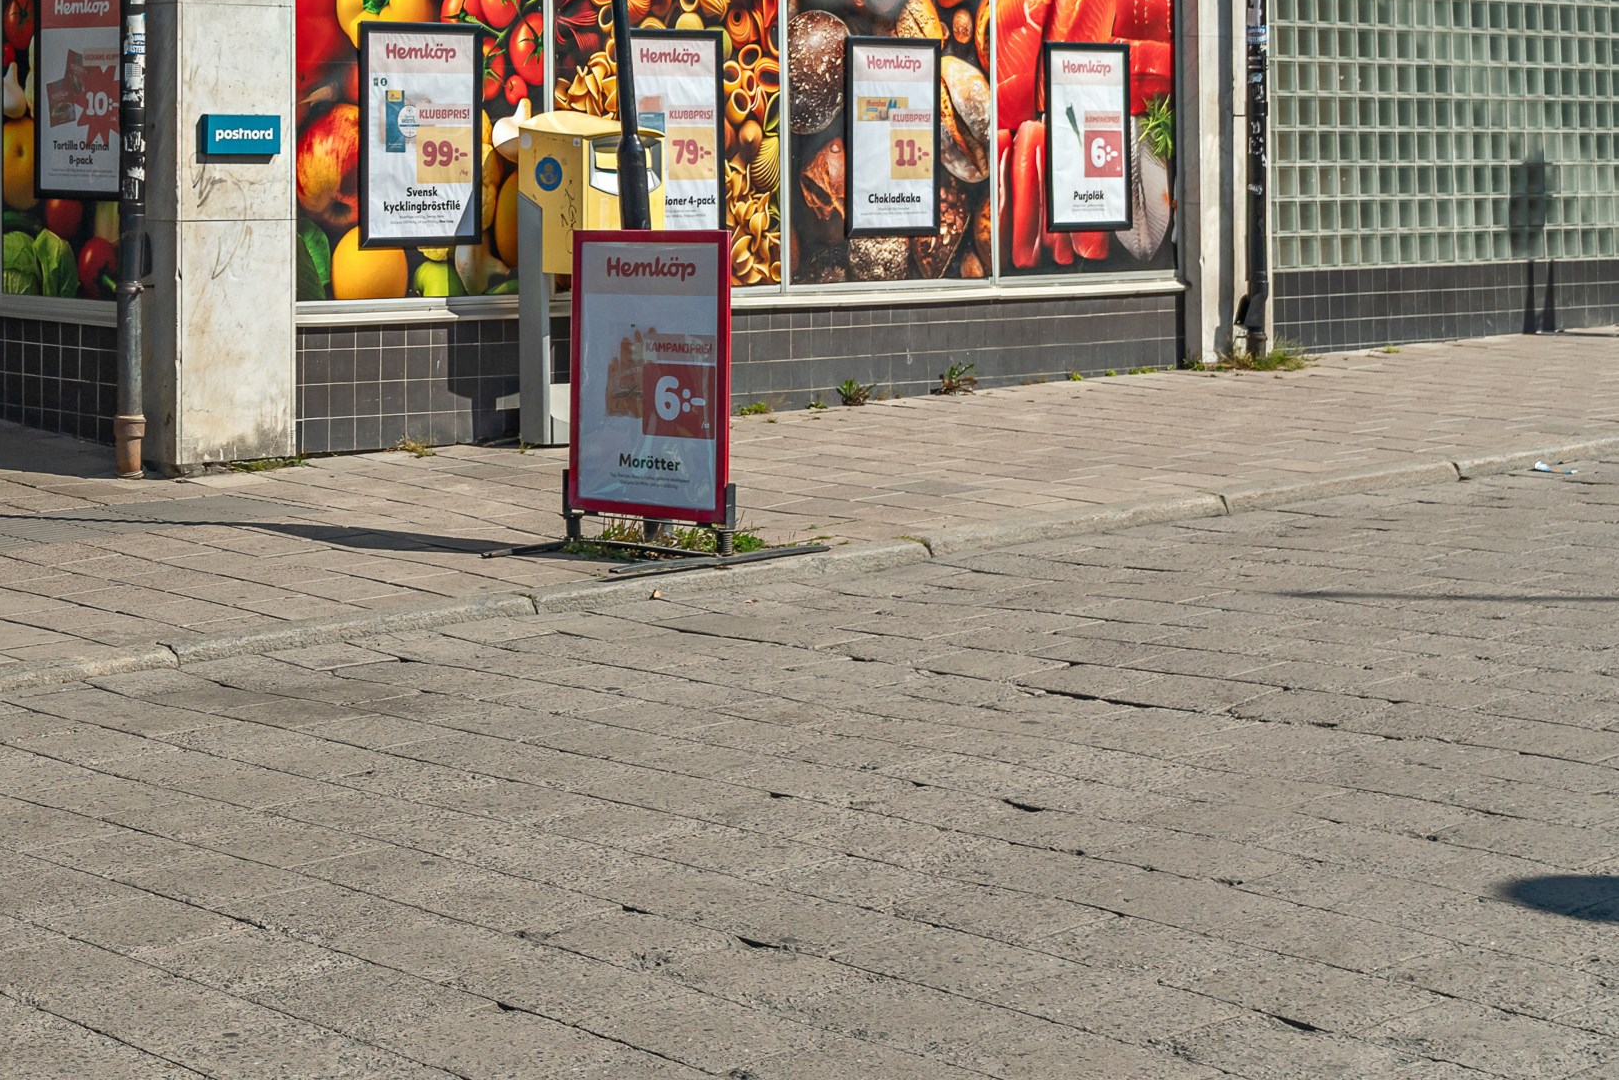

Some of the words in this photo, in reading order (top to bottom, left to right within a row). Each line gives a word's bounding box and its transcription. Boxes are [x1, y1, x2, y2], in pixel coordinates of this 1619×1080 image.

[385, 43, 457, 64] Hemköp
[639, 47, 701, 67] Hemköp
[866, 55, 922, 73] Hemköp
[1062, 59, 1112, 75] Hemköp
[419, 108, 471, 120] KLUBBPRIS!
[669, 109, 714, 121] KLUBBPRIS!
[892, 113, 931, 123] KLUBBPRIS!
[215, 127, 274, 142] postnord
[53, 140, 78, 151] Tortilla
[79, 140, 110, 154] Original
[69, 154, 94, 167] 8-pack
[406, 187, 438, 198] Svensk
[868, 192, 921, 204] Chokladkaka
[1073, 190, 1104, 203] Purjolök
[383, 200, 461, 214] kycklingbröstfilé
[688, 194, 716, 208] 4-pack
[606, 256, 696, 282] Hemköp
[645, 342, 713, 355] KAMPANJPRIS!
[618, 452, 681, 472] Morötter
